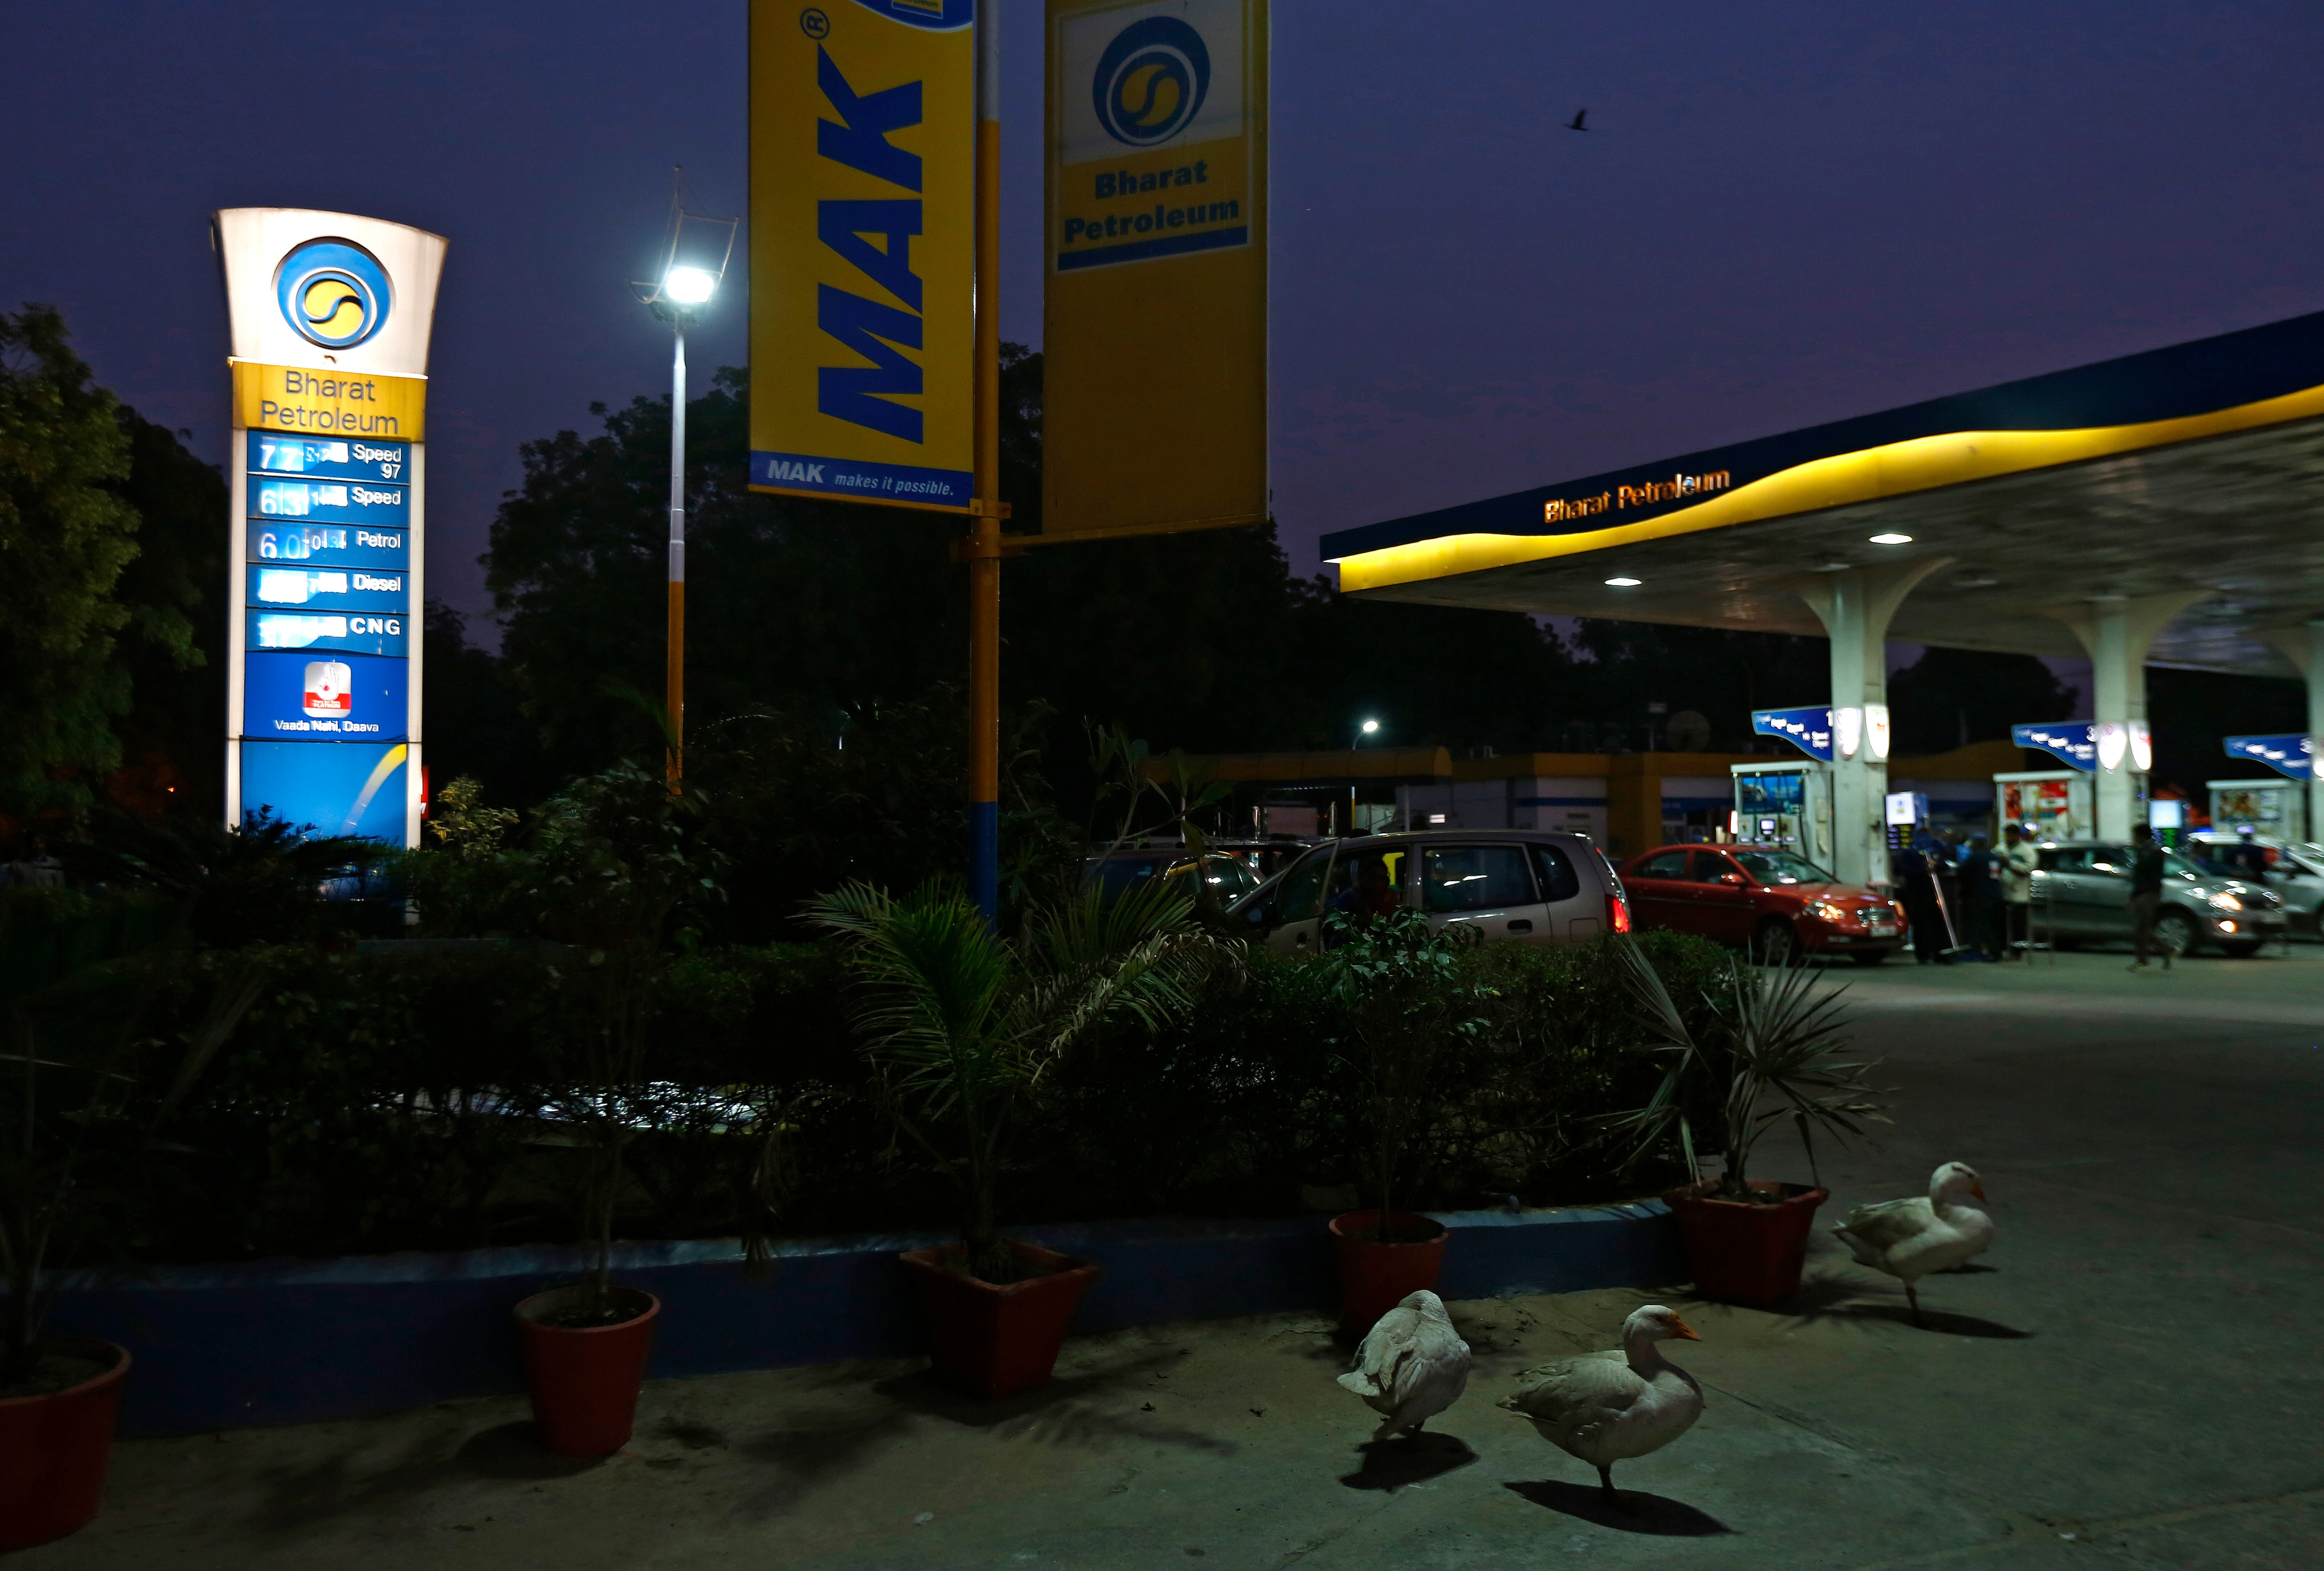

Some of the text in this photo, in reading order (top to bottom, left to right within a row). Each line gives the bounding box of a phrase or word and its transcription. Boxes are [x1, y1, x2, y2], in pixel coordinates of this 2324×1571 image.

[1095, 159, 1208, 199] Bharat
[1064, 200, 1239, 244] Petroleum
[818, 42, 923, 445] MAK
[286, 370, 376, 402] Bharat
[262, 400, 398, 434] Petroleum
[353, 443, 402, 464] Speed
[382, 464, 402, 479] 97
[767, 459, 954, 497] MAK makes it possible.
[352, 486, 402, 507] Speed
[1544, 469, 1730, 524] Bharat Petroleum
[357, 530, 401, 549] Petrol
[354, 573, 401, 592] Diesel
[350, 617, 401, 636] CNG
[274, 719, 310, 732] Vaada
[343, 720, 379, 733] Daava
